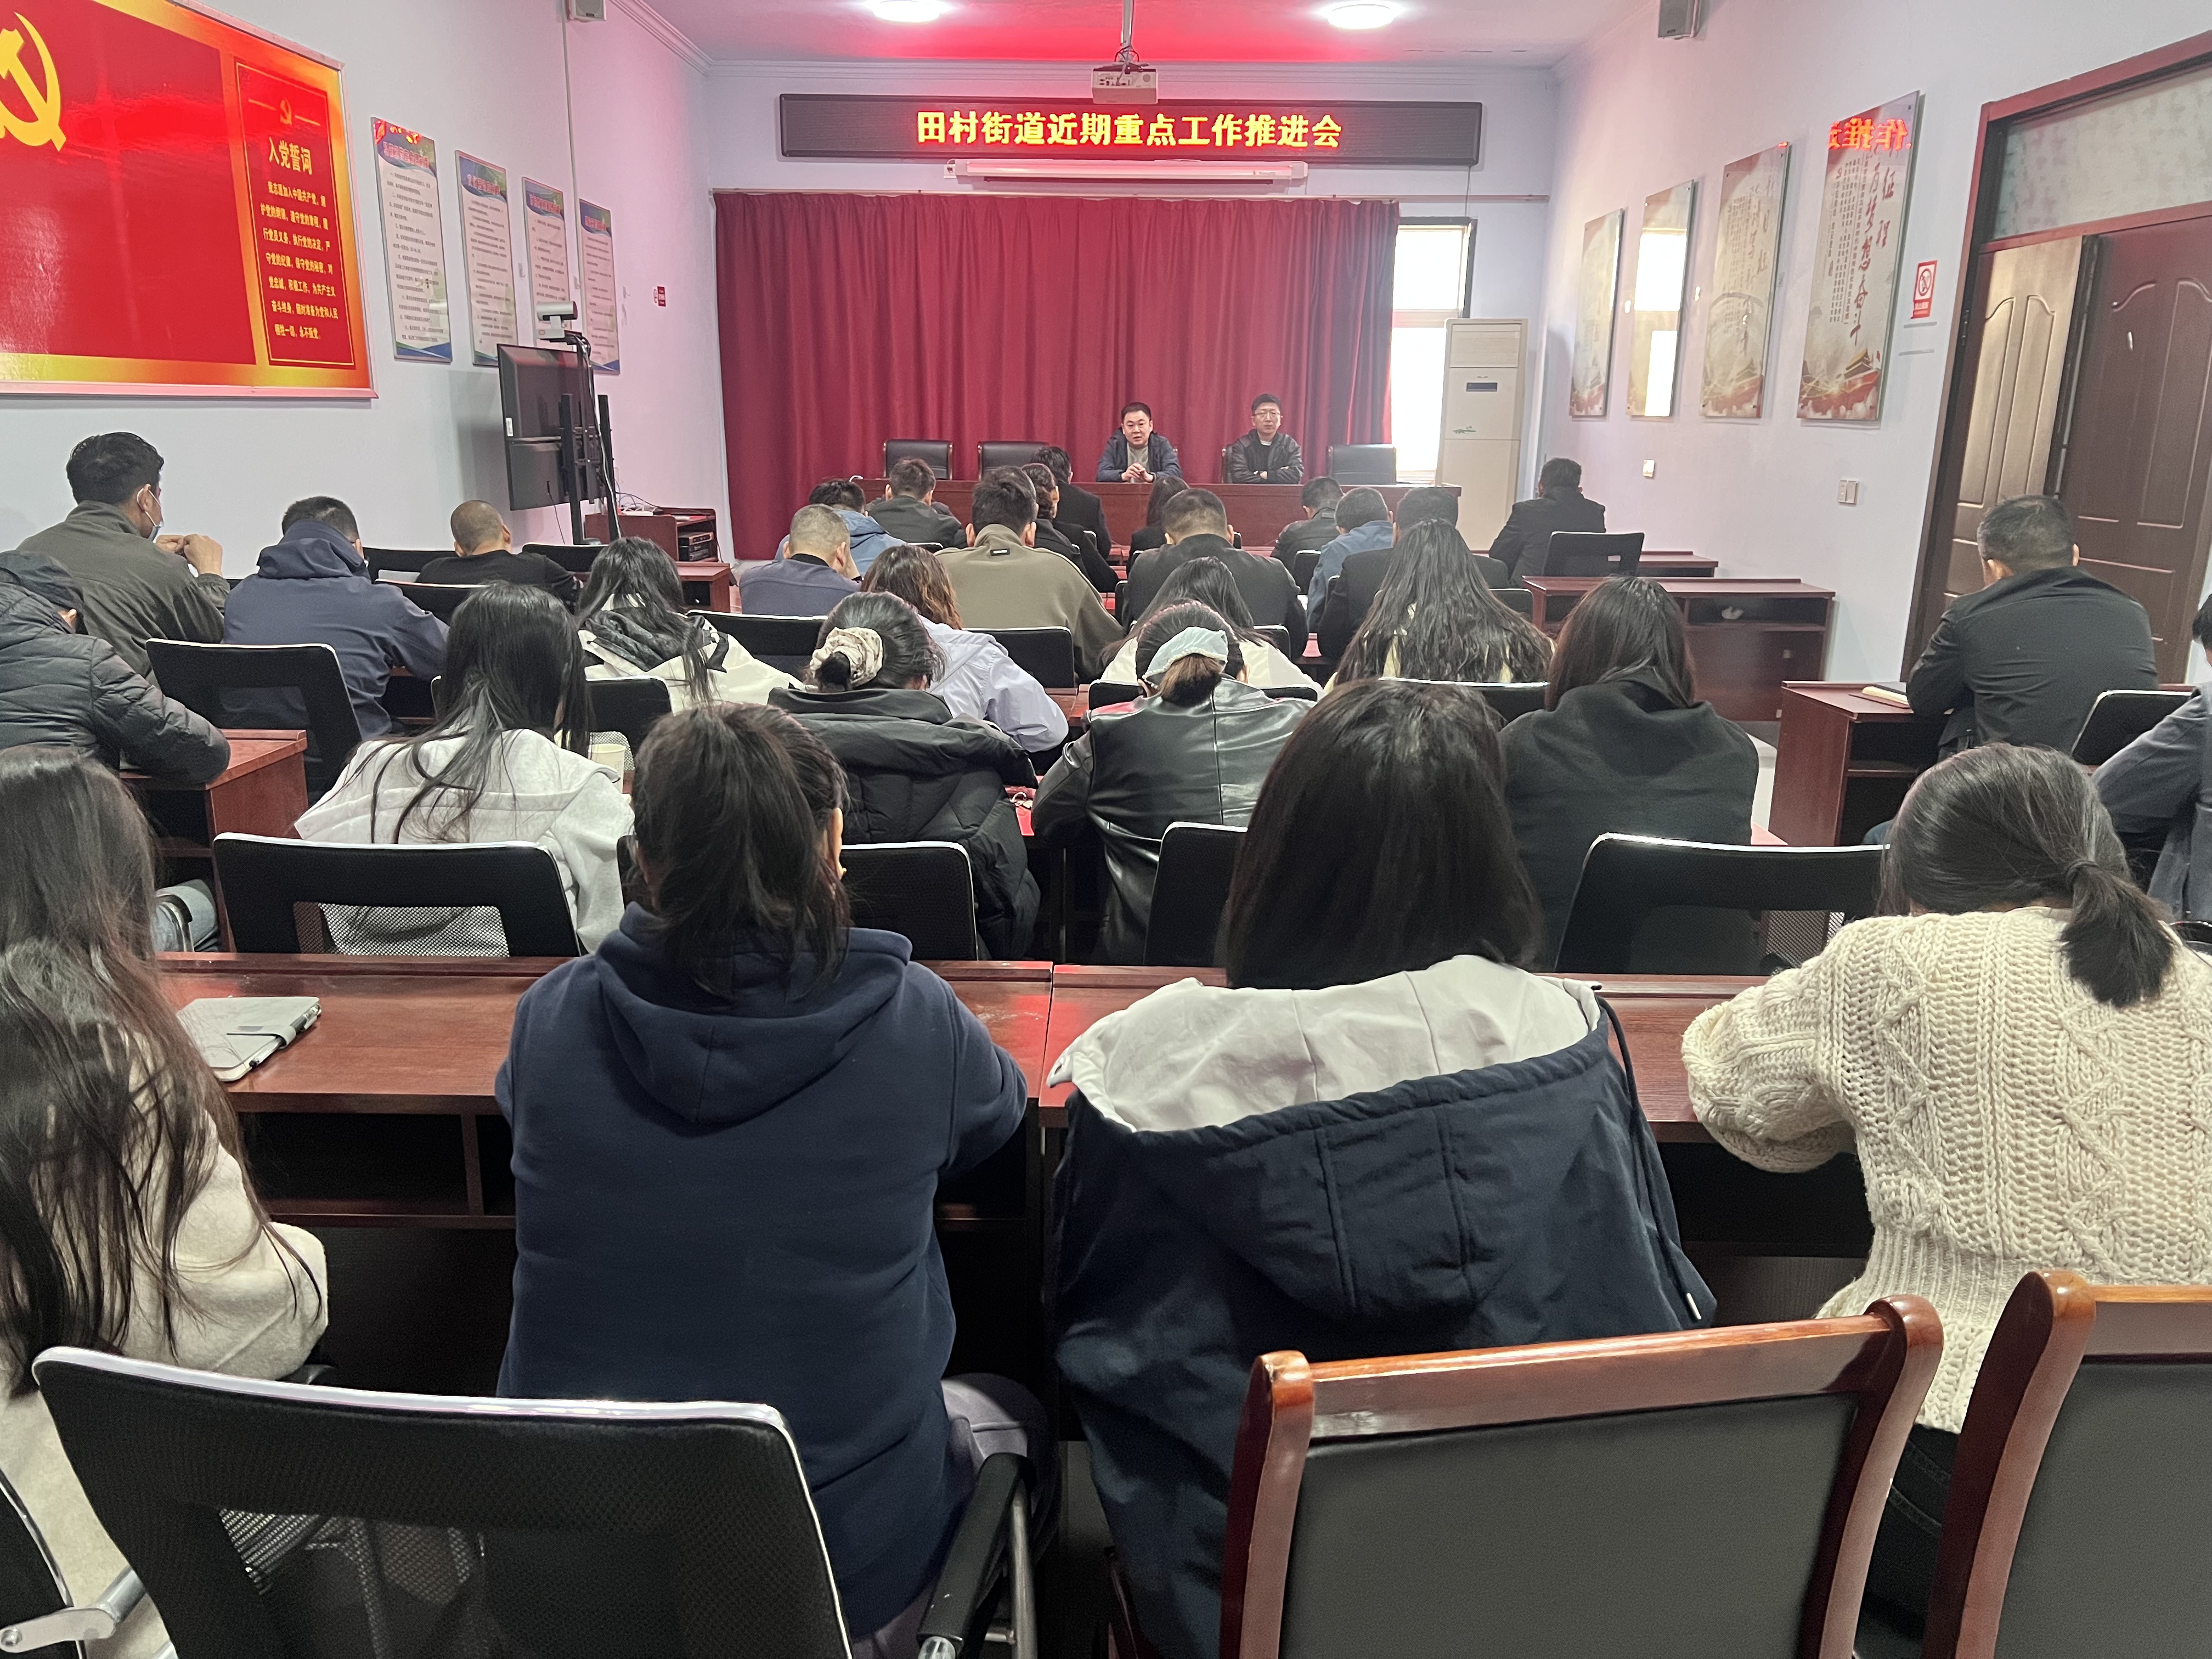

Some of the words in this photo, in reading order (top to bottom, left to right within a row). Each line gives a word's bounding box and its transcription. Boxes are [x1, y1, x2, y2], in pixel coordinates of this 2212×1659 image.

[917, 111, 1342, 148] 田村街道近期重点工作推进会
[269, 137, 312, 175] 入党誓词
